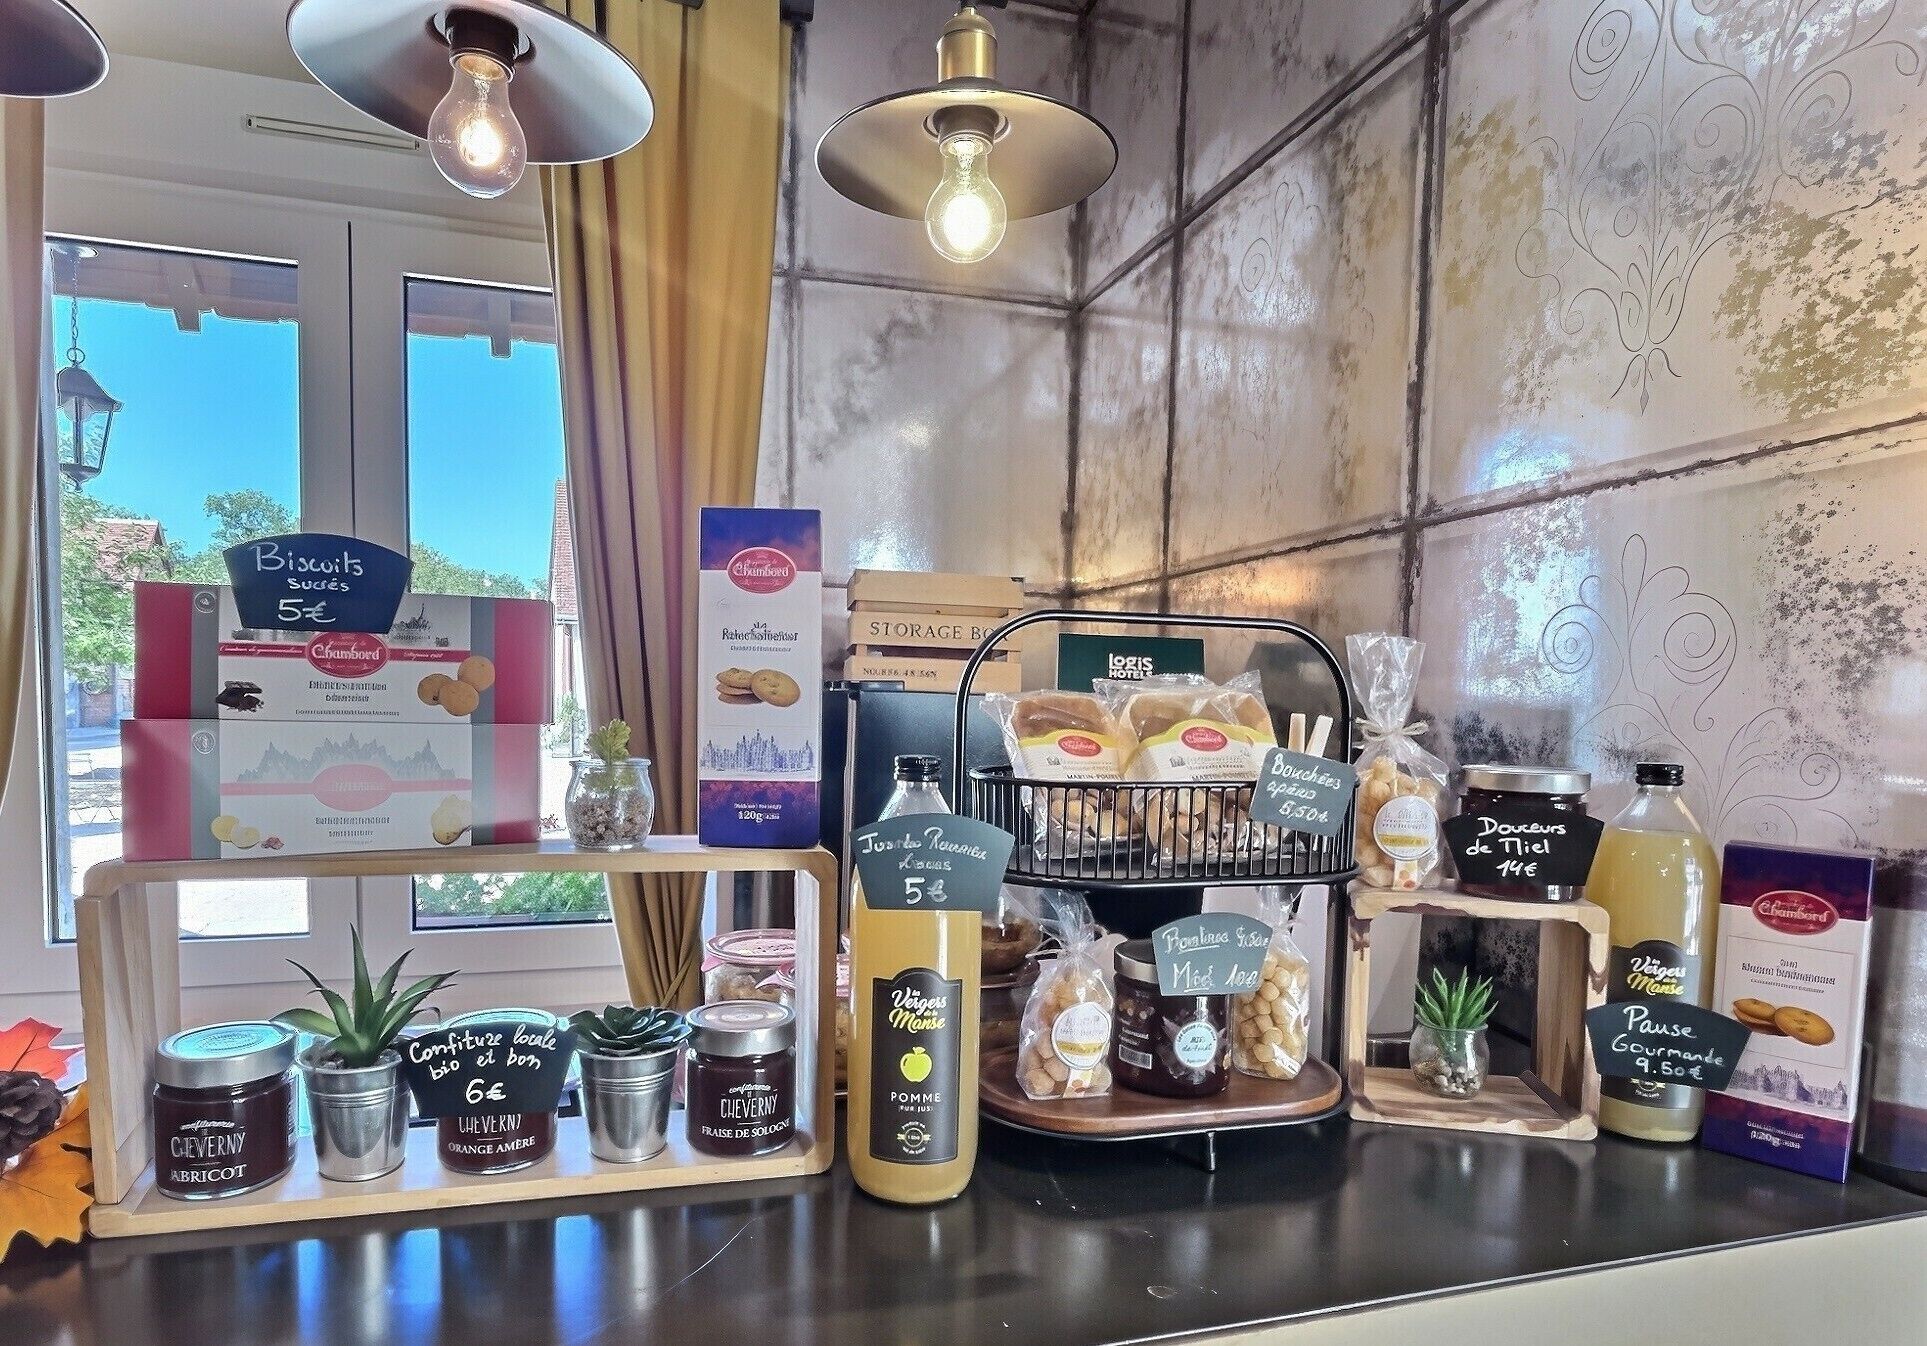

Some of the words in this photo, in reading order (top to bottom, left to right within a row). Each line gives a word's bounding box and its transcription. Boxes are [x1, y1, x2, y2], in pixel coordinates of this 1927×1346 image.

[250, 542, 364, 576] Biscuits
[869, 621, 963, 640] STORAGE
[971, 626, 1009, 643] BO
[311, 641, 382, 660] Chambord
[1477, 816, 1567, 837] Douceurs
[1466, 838, 1492, 855] de
[891, 986, 948, 1016] Vergers
[888, 1007, 946, 1034] Manse
[1623, 1005, 1697, 1039] Pause
[409, 1030, 503, 1064] Confiture
[513, 1023, 557, 1051] locale
[1611, 1033, 1725, 1067] Gourmande
[429, 1060, 460, 1080] bio
[476, 1049, 496, 1067] et
[506, 1047, 541, 1070] bon
[465, 1078, 507, 1104] 6€
[890, 1091, 942, 1104] POMME
[720, 1093, 778, 1119] CHEVERNY
[701, 1125, 733, 1139] FRAISE
[735, 1128, 750, 1139] DE
[447, 1142, 494, 1155] ORANGE
[496, 1136, 536, 1153] AMÈRE
[170, 1164, 248, 1183] ABRICOT
